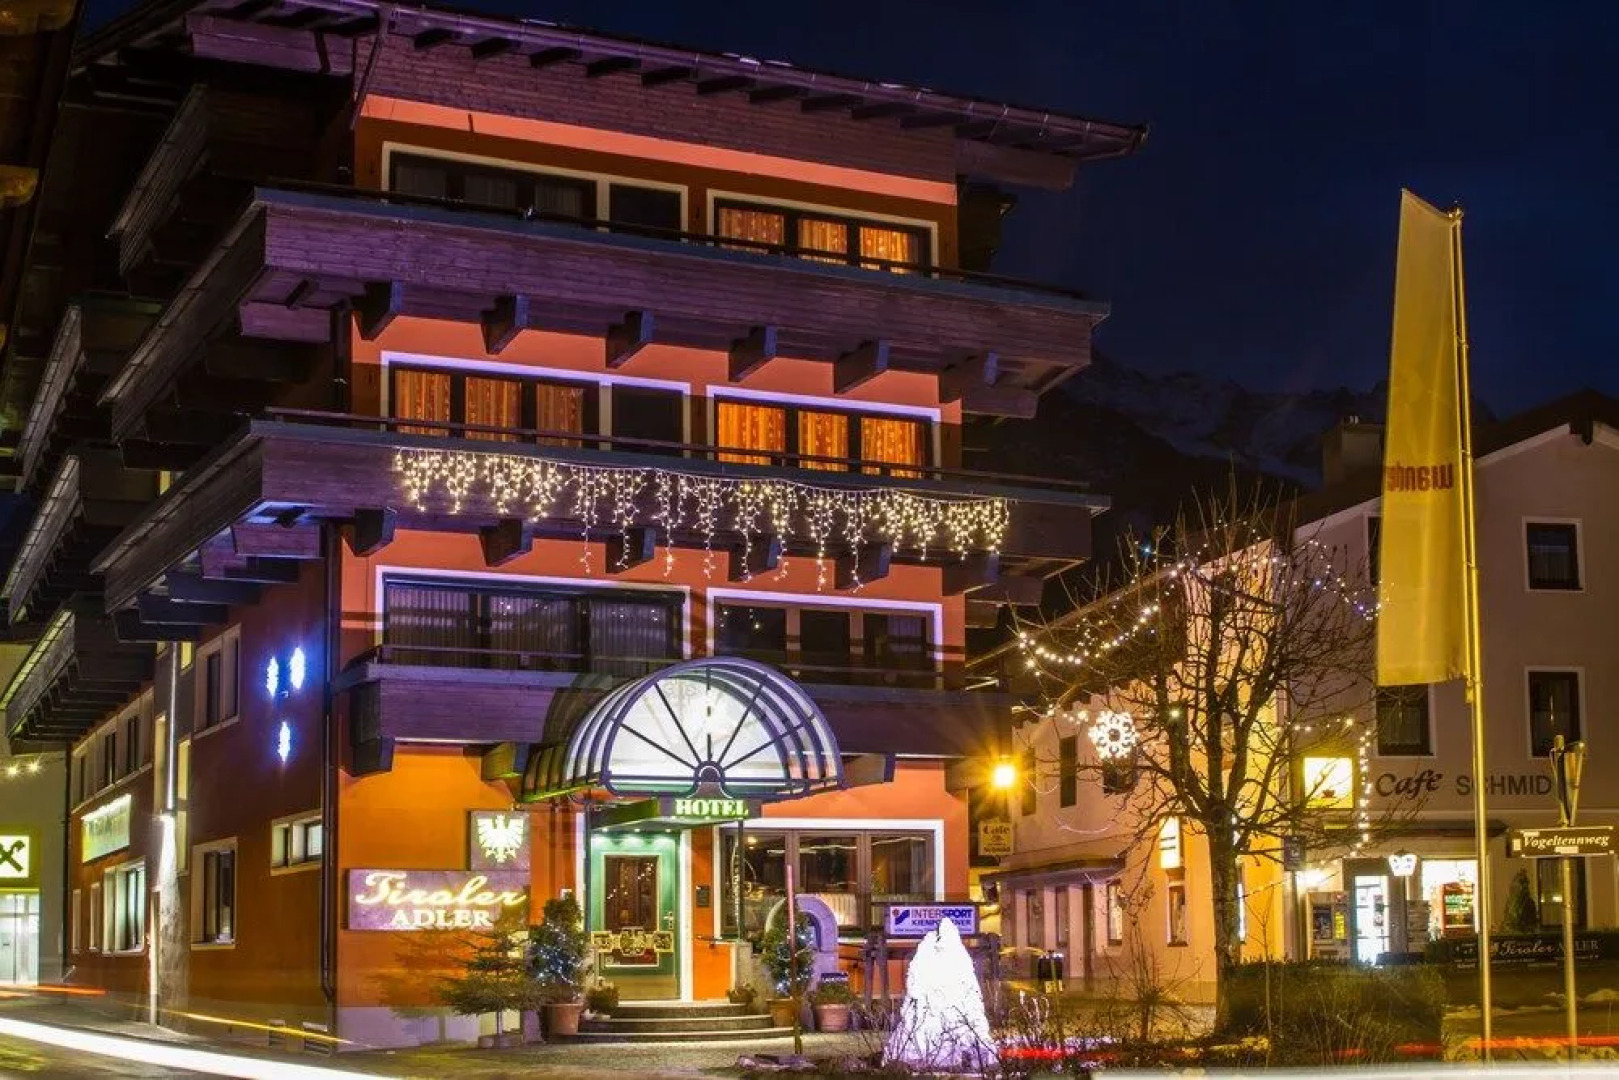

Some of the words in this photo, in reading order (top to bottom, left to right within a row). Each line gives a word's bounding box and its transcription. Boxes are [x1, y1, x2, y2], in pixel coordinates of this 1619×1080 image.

[675, 799, 749, 816] HOTEL
[355, 872, 527, 906] Tiroler
[390, 909, 494, 928] ADLER
[912, 908, 973, 919] INTERSPORT
